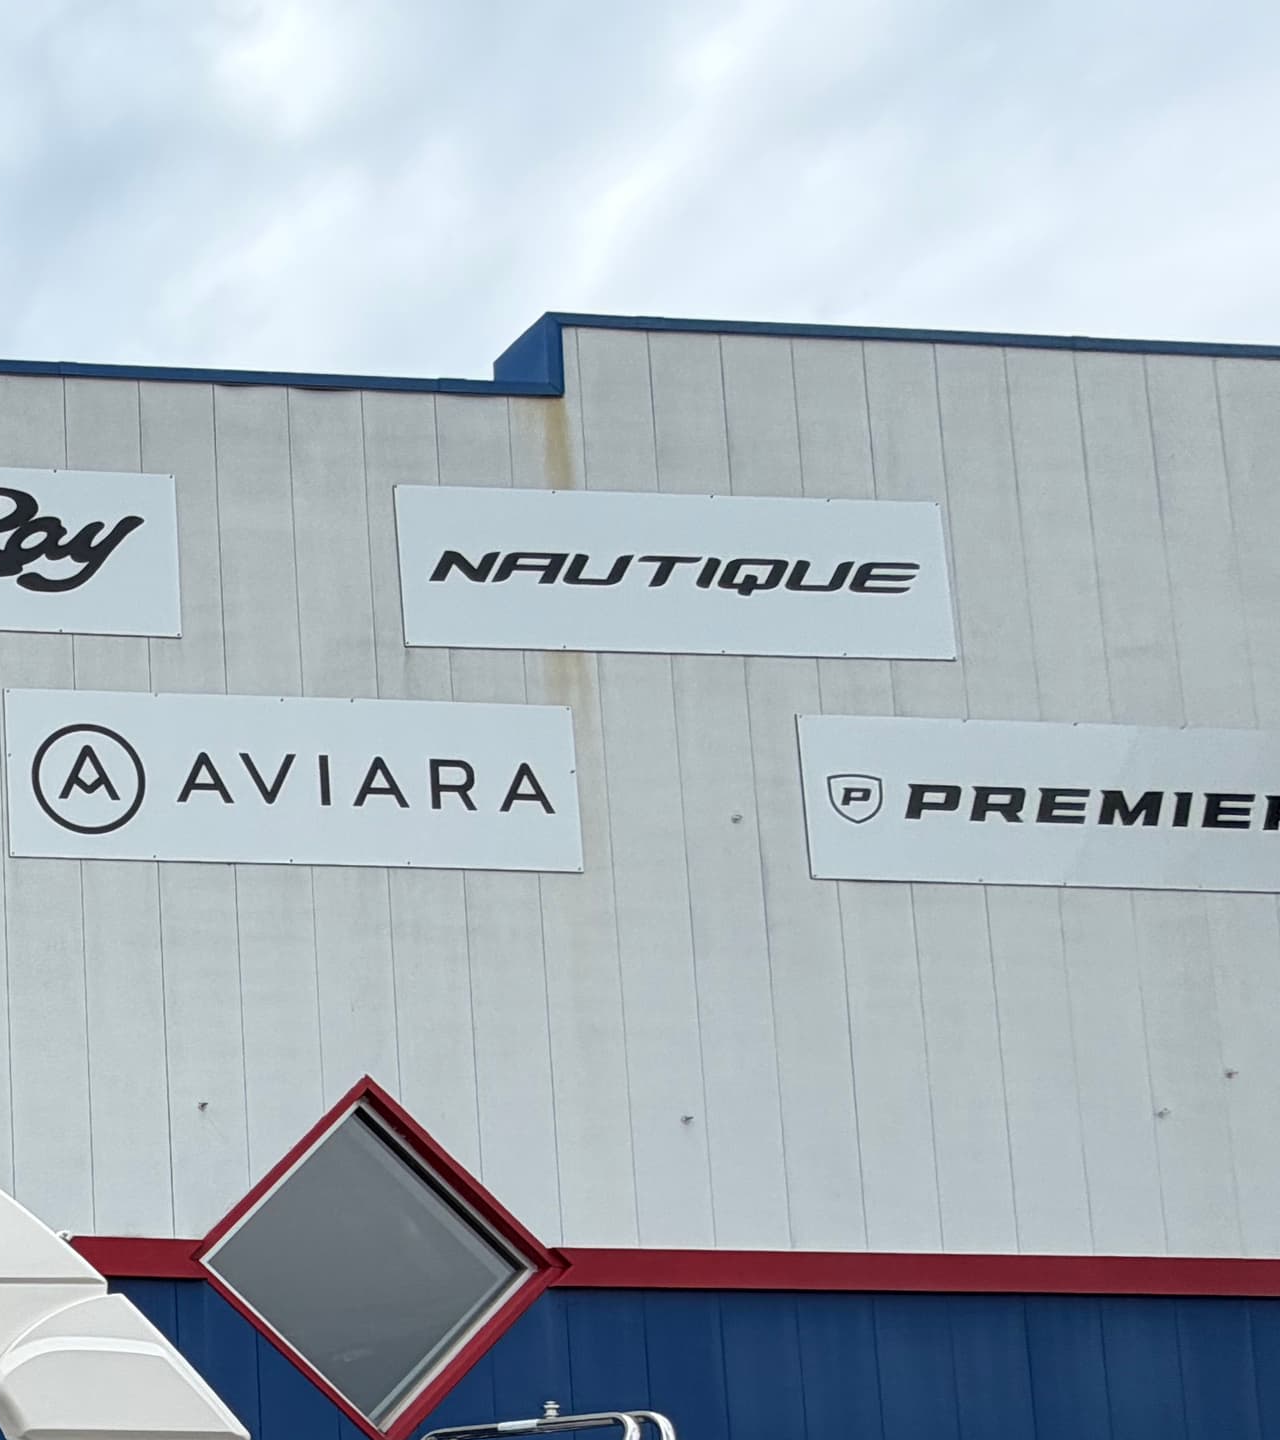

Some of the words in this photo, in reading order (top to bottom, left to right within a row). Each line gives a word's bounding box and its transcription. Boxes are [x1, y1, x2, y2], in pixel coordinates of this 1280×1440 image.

[429, 550, 920, 596] NAUTIQUE
[177, 751, 556, 814] AVIARA
[841, 787, 872, 806] P
